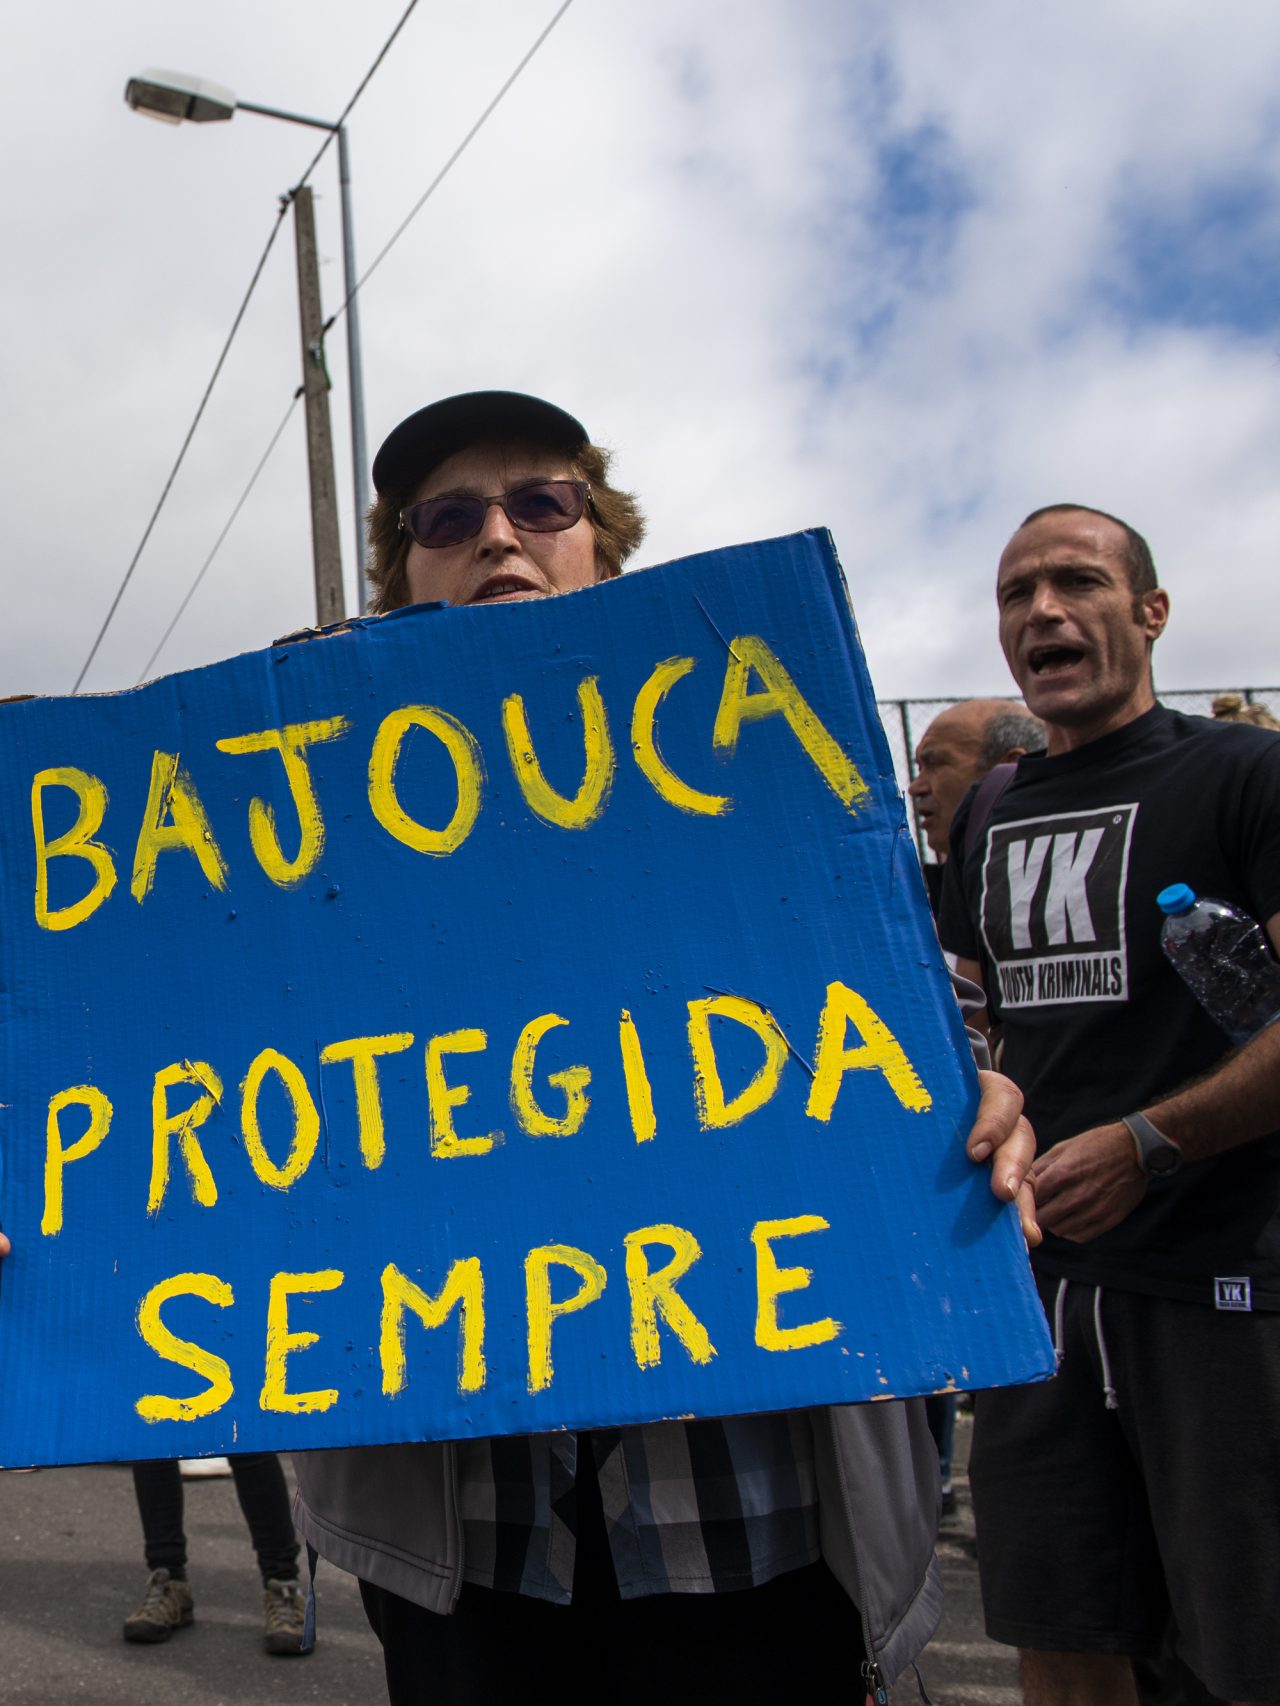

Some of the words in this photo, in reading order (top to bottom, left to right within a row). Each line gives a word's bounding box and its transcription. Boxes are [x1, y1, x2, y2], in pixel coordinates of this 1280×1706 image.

[31, 634, 869, 932] BAJOUCA
[1007, 827, 1106, 950] YK
[1000, 965, 1034, 1003] YOUTH
[1038, 956, 1122, 1000] KRIMINALS
[40, 980, 932, 1236] PROTEGIDA
[135, 1213, 842, 1424] SEMPRE
[1222, 1284, 1242, 1300] YK
